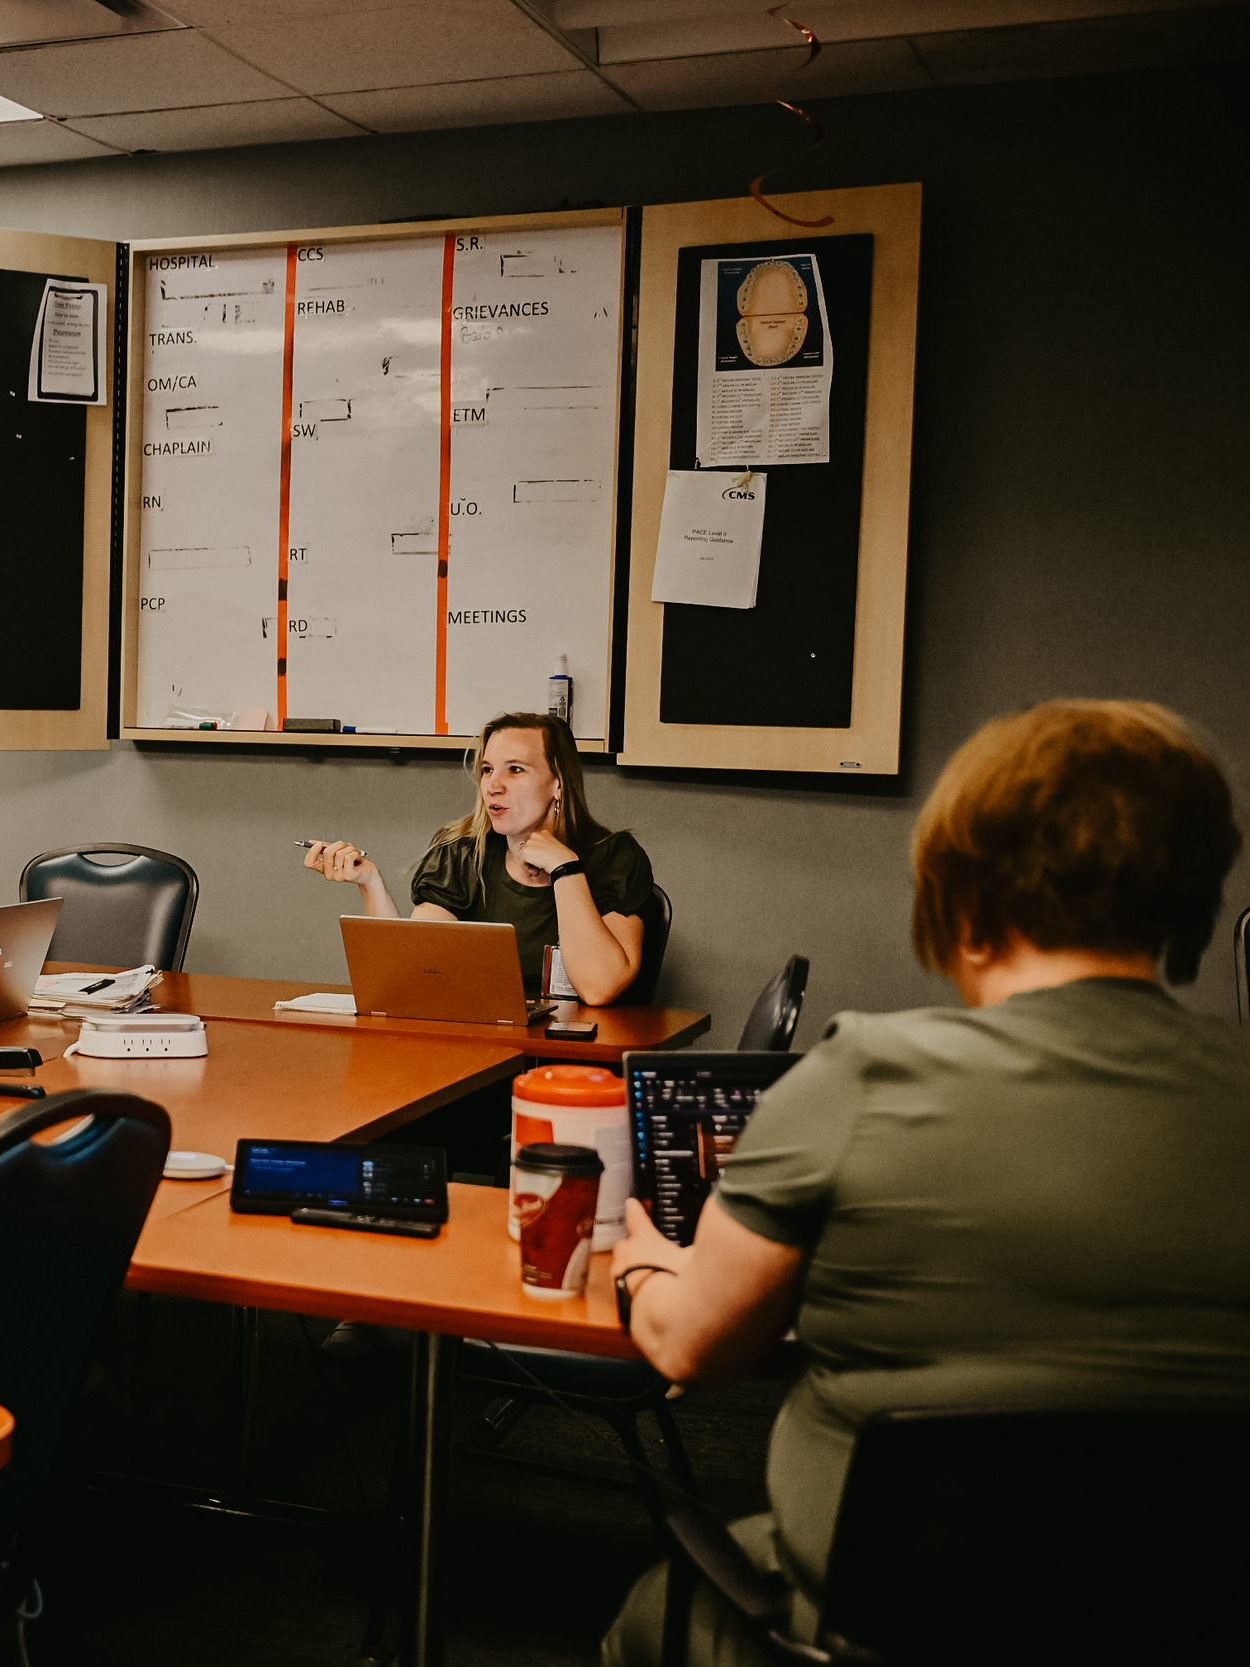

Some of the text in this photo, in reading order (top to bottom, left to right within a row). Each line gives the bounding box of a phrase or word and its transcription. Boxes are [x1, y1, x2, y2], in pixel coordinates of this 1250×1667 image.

[456, 237, 483, 251] S.R.
[298, 247, 324, 262] CCS
[149, 254, 215, 271] HOSPITAL
[297, 300, 345, 315] REHAB
[452, 301, 549, 321] GRIEVANCES
[149, 331, 197, 347] TRANS.
[147, 375, 197, 392] OM/CA
[453, 408, 486, 422] ETM
[293, 424, 317, 438] SW
[143, 440, 211, 456] CHAPLAIN
[143, 496, 161, 509] RN
[729, 491, 756, 500] CMS
[450, 501, 482, 516] U.O.
[290, 548, 307, 561] RT
[141, 597, 166, 610] PCP
[448, 609, 527, 625] MEETINGS
[289, 619, 308, 632] RD
